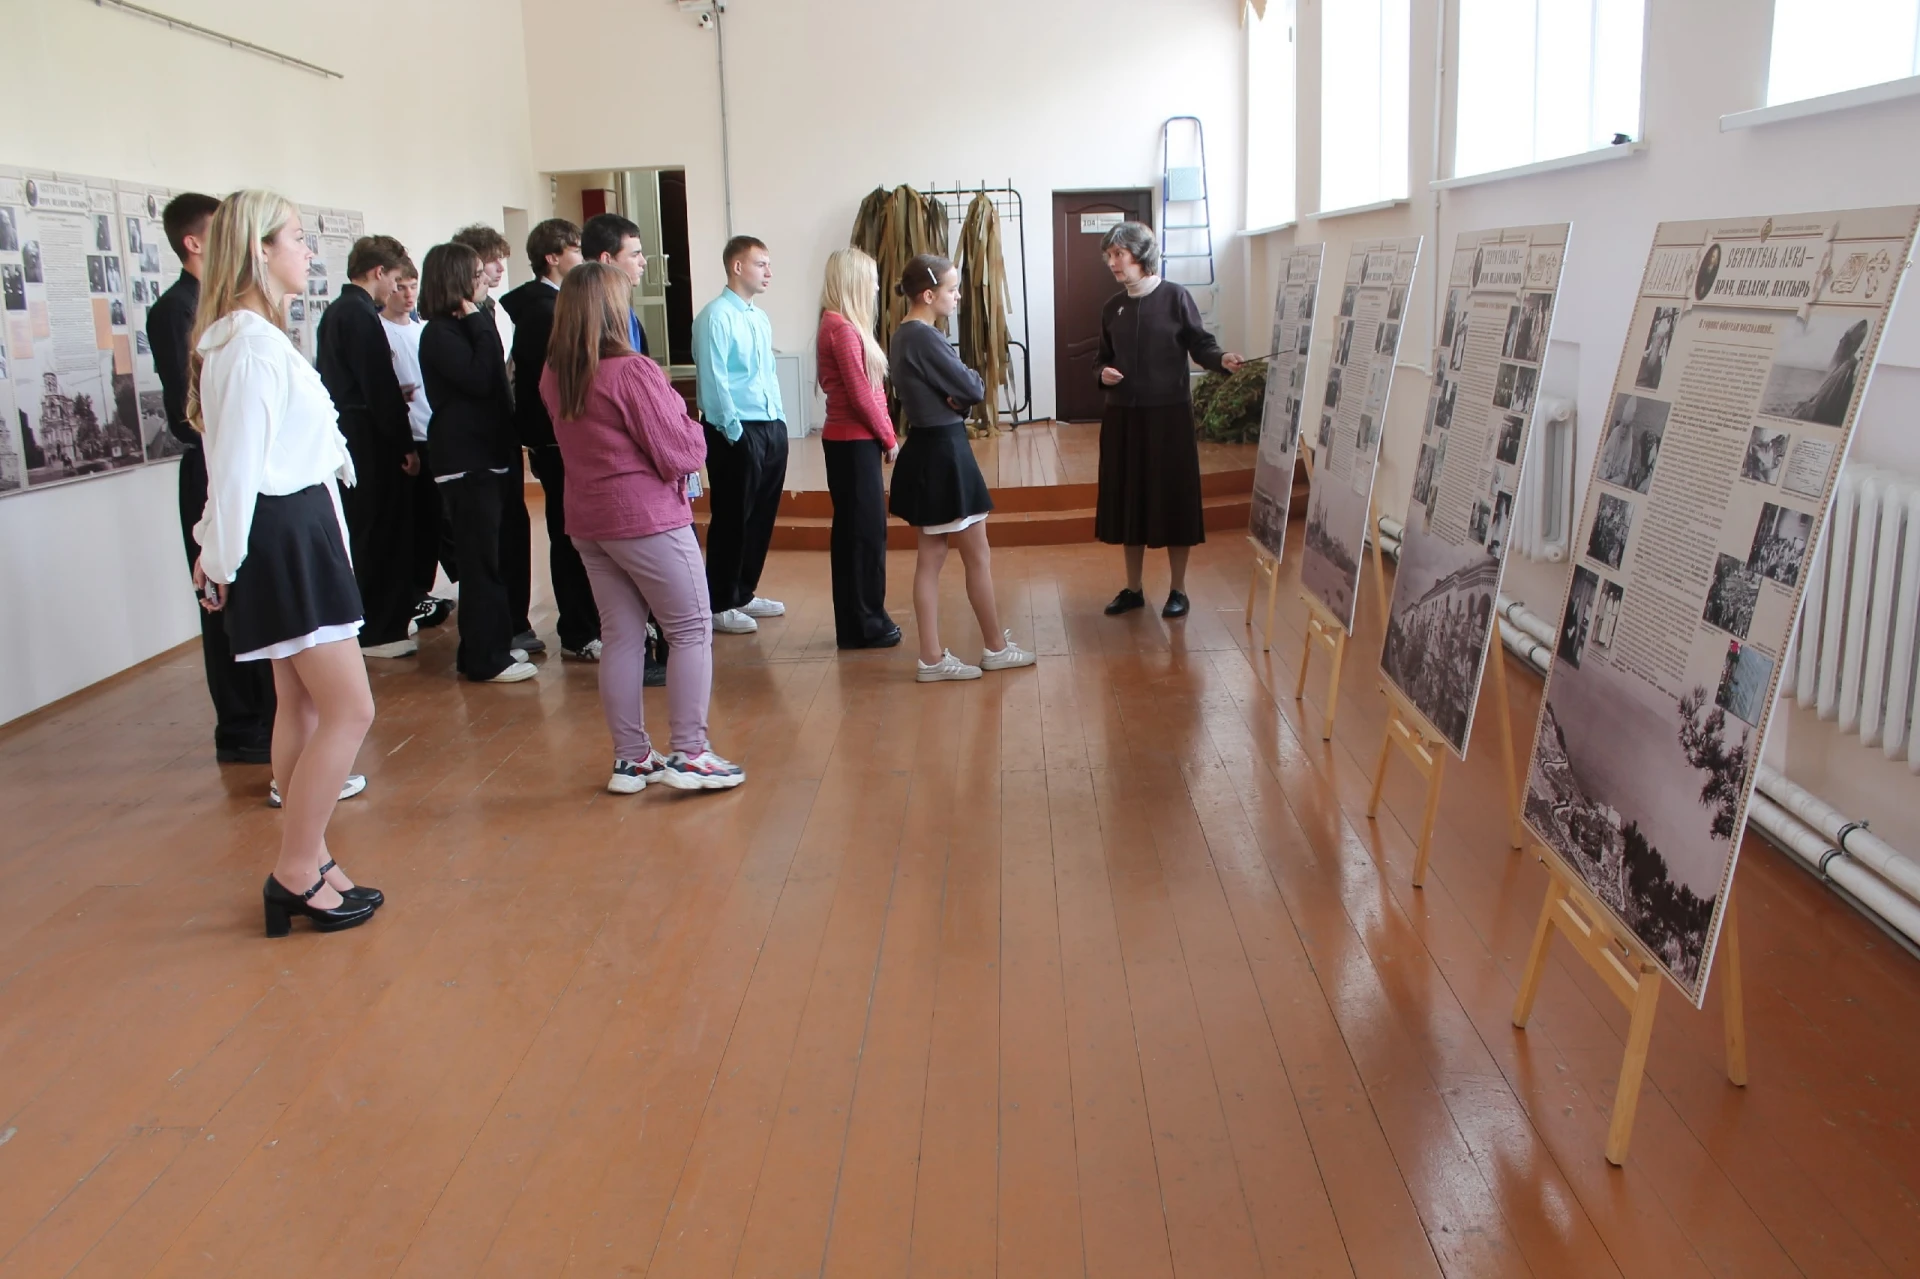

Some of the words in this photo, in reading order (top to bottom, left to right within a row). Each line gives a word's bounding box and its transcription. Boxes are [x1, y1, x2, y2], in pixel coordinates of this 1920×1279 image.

[1726, 246, 1779, 268] СВЯТИТЕЛЬ
[1713, 279, 1735, 297] ВРАЧ,
[1735, 279, 1770, 298] ПЕДАГОГ,
[1771, 279, 1811, 298] ПАСТЫРЬ
